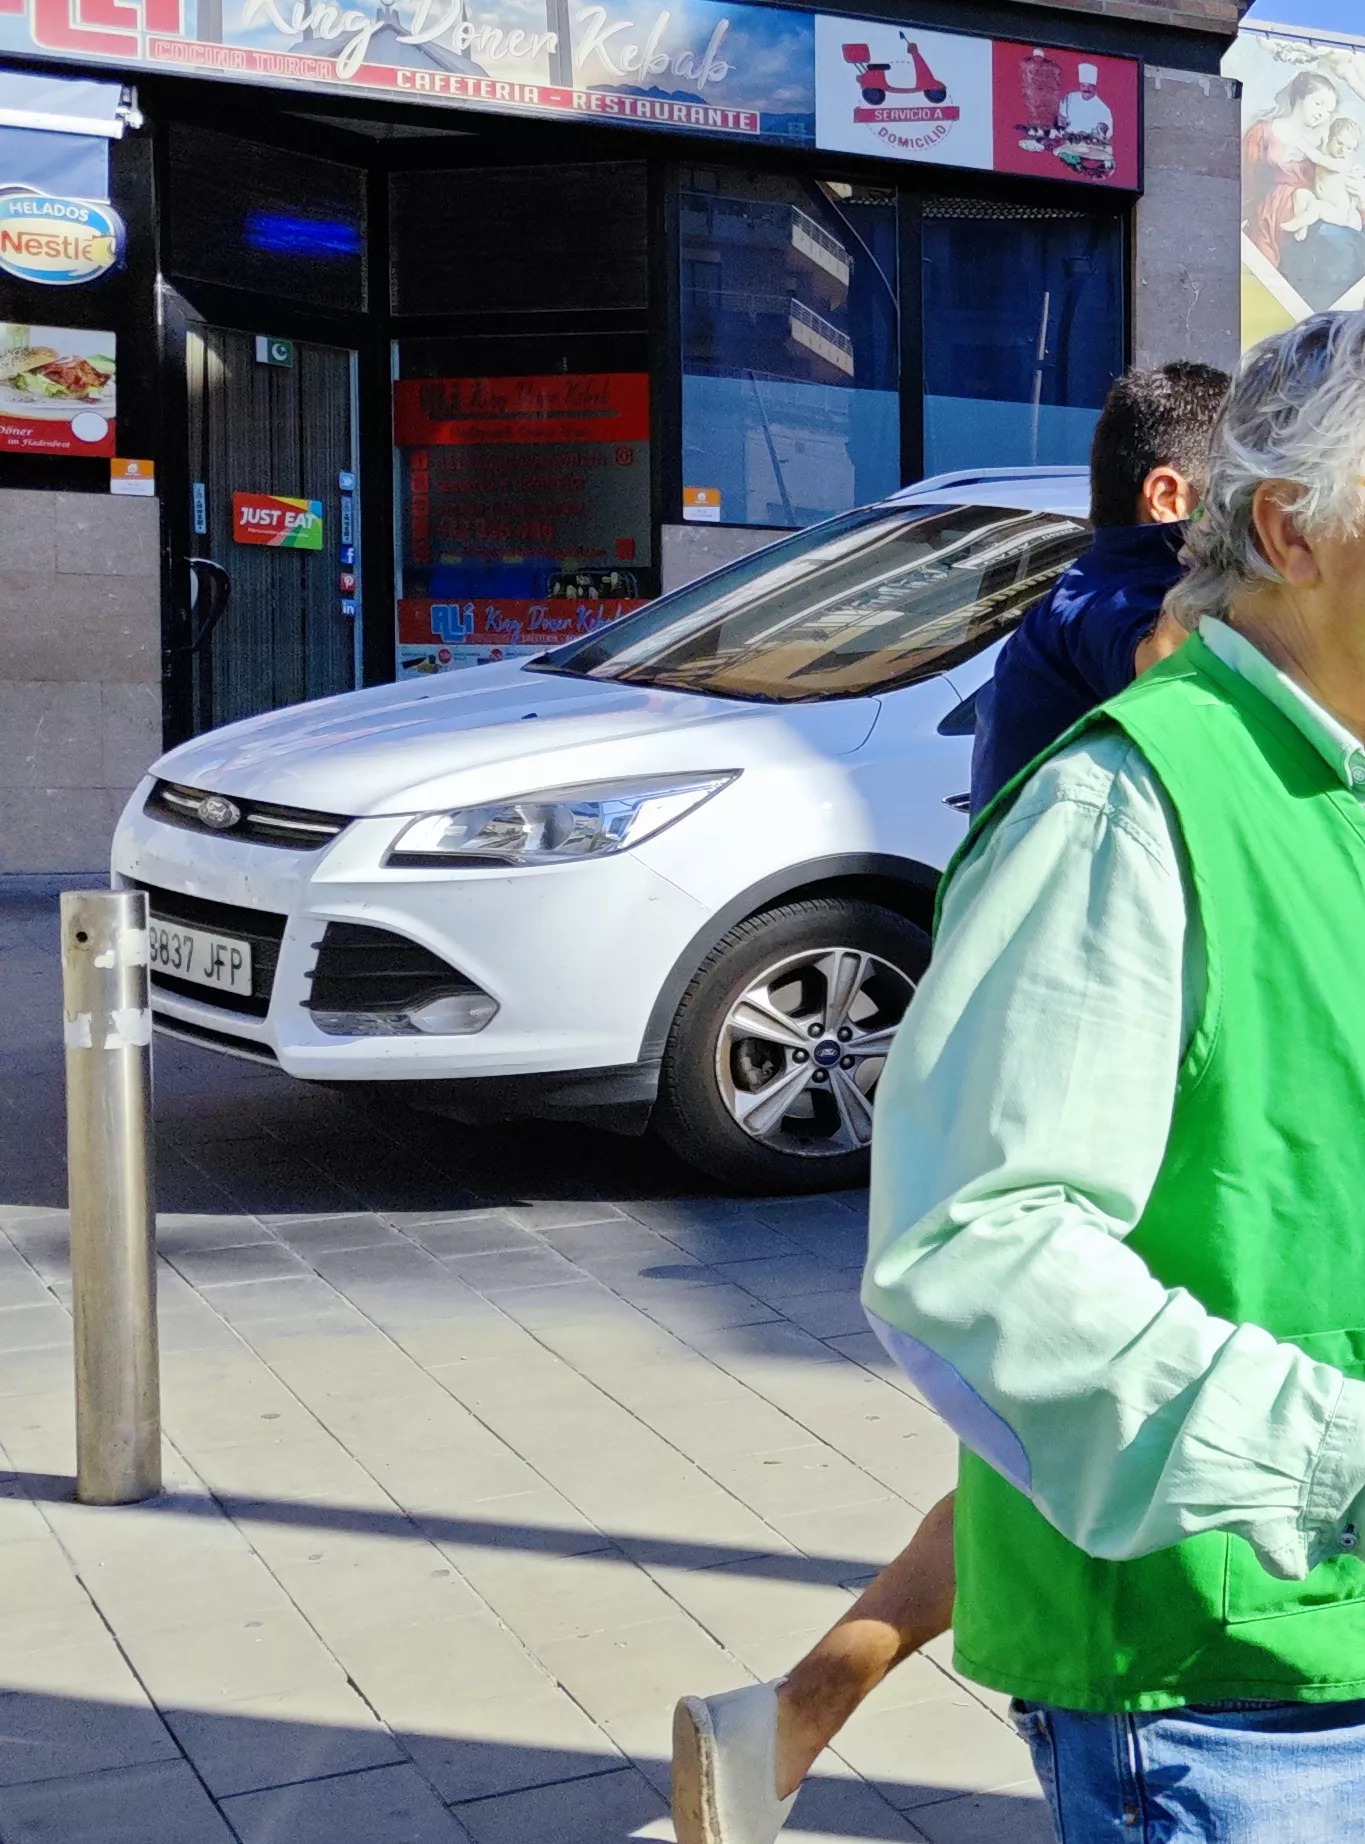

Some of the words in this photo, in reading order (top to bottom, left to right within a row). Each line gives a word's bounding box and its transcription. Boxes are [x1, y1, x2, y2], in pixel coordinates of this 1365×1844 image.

[154, 41, 247, 69] COCINA
[253, 52, 332, 79] TURCA
[576, 6, 736, 91] Kebab
[396, 70, 539, 104] CAFETERIA
[572, 94, 752, 130] RESTAURANTE
[874, 108, 930, 121] SERVICIO
[934, 107, 943, 119] A
[878, 124, 947, 149] DOMICILIO
[9, 201, 89, 222] HELADOS
[240, 507, 281, 525] JUST
[284, 511, 314, 529] EAT
[203, 941, 243, 986] JFP
